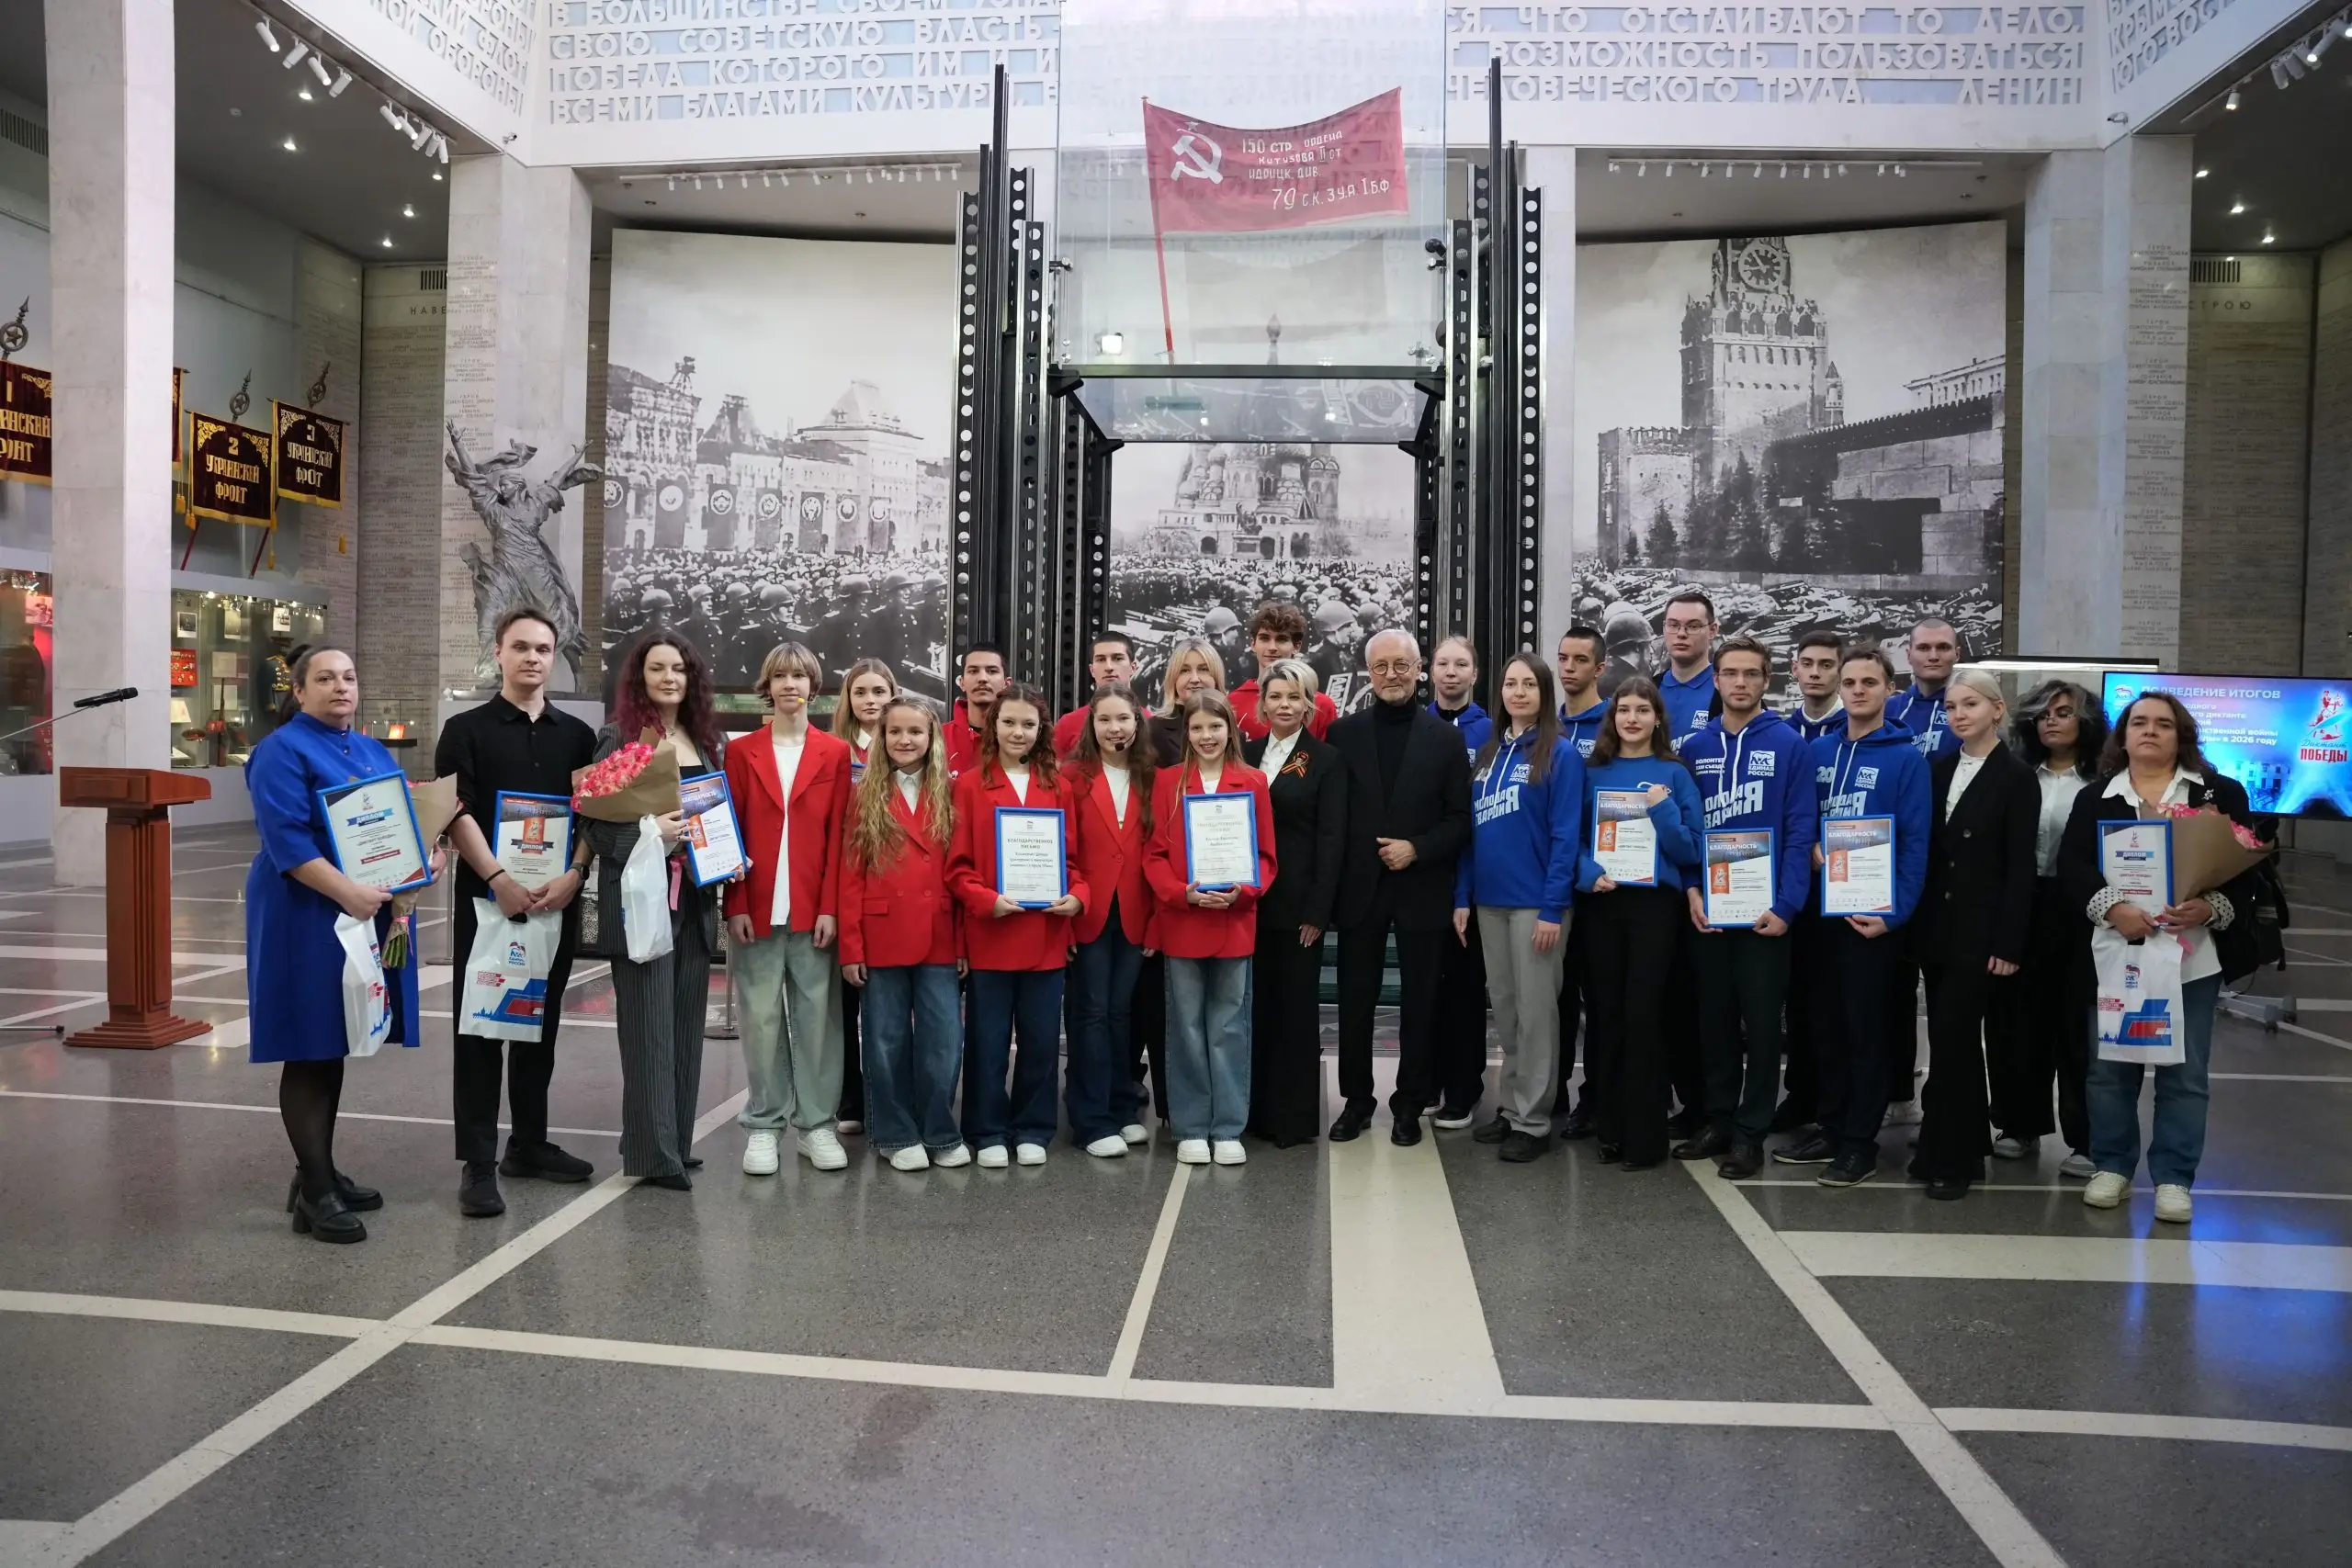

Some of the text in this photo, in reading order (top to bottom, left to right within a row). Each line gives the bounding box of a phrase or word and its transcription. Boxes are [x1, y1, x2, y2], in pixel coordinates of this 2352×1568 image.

[551, 3, 570, 27] В
[587, 0, 817, 25] БОЛЬШИНСТВЕ
[1517, 7, 1589, 33] ЧТО
[1621, 7, 1866, 34] ОТСТАИВАЮТ
[1894, 8, 1944, 34] ТО
[1974, 6, 2084, 35] ДЕЛО,
[679, 20, 884, 53] СОВЕТСКУЮ
[917, 16, 1043, 44] ВЛАСТЬ
[1489, 41, 1770, 69] ВОЗМОЖНОСТЬ
[1797, 43, 2081, 69] ПОЛЬЗОВАТЬСЯ
[428, 26, 524, 117] ОБОРОНЫ
[551, 62, 684, 92] ПОБЕДА
[709, 54, 885, 85] КОТОРОГО
[913, 51, 962, 77] ИМ
[551, 96, 655, 125] ВСЕМИ
[684, 88, 825, 119] БЛАГАМИ
[853, 81, 1026, 112] КУЛЬТУР,
[1757, 77, 1872, 104] ТРУДА.
[1957, 78, 2080, 105] ЛЕНИН
[1242, 138, 1266, 154] 150
[1272, 187, 1296, 210] 79
[228, 436, 239, 456] 2
[306, 424, 315, 442] 3
[2228, 688, 2281, 699] ИТОГОВ
[2231, 736, 2255, 744] 2026
[2301, 748, 2348, 763] ПОБЕДЫ
